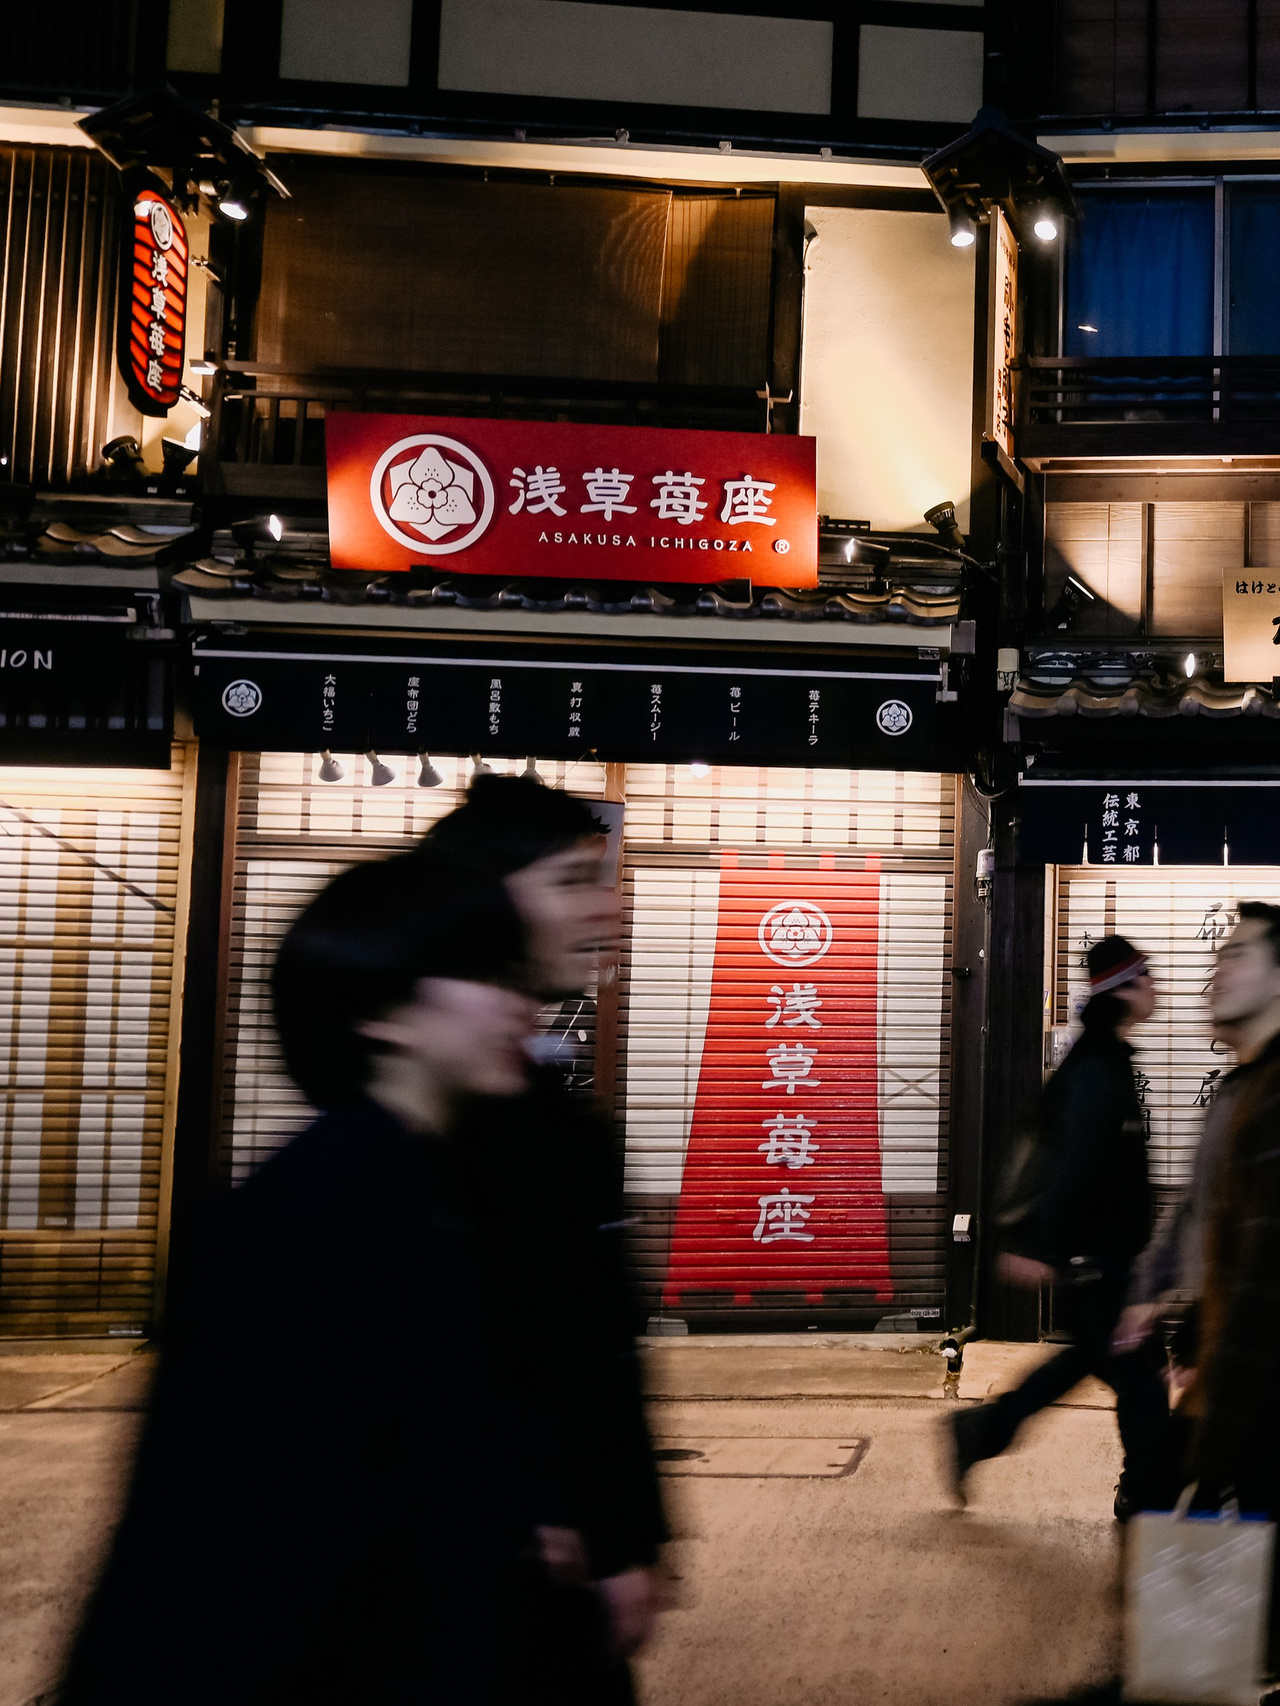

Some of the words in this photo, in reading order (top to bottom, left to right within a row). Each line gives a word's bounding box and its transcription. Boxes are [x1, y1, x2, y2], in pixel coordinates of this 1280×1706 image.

[146, 250, 168, 392] 浅草苺座
[508, 465, 778, 527] 浅草苺座
[538, 531, 637, 548] ASAKUSA
[651, 536, 754, 552] ICHIGOZA
[322, 674, 337, 732] 大福いちご
[406, 676, 420, 733] 座布団どら
[728, 686, 742, 742] 苺ビール
[808, 689, 821, 746] 苺テキーラ
[1102, 792, 1120, 862] 伝統工芸
[1123, 792, 1142, 862] 東京都
[753, 982, 823, 1244] 浅草苺座
